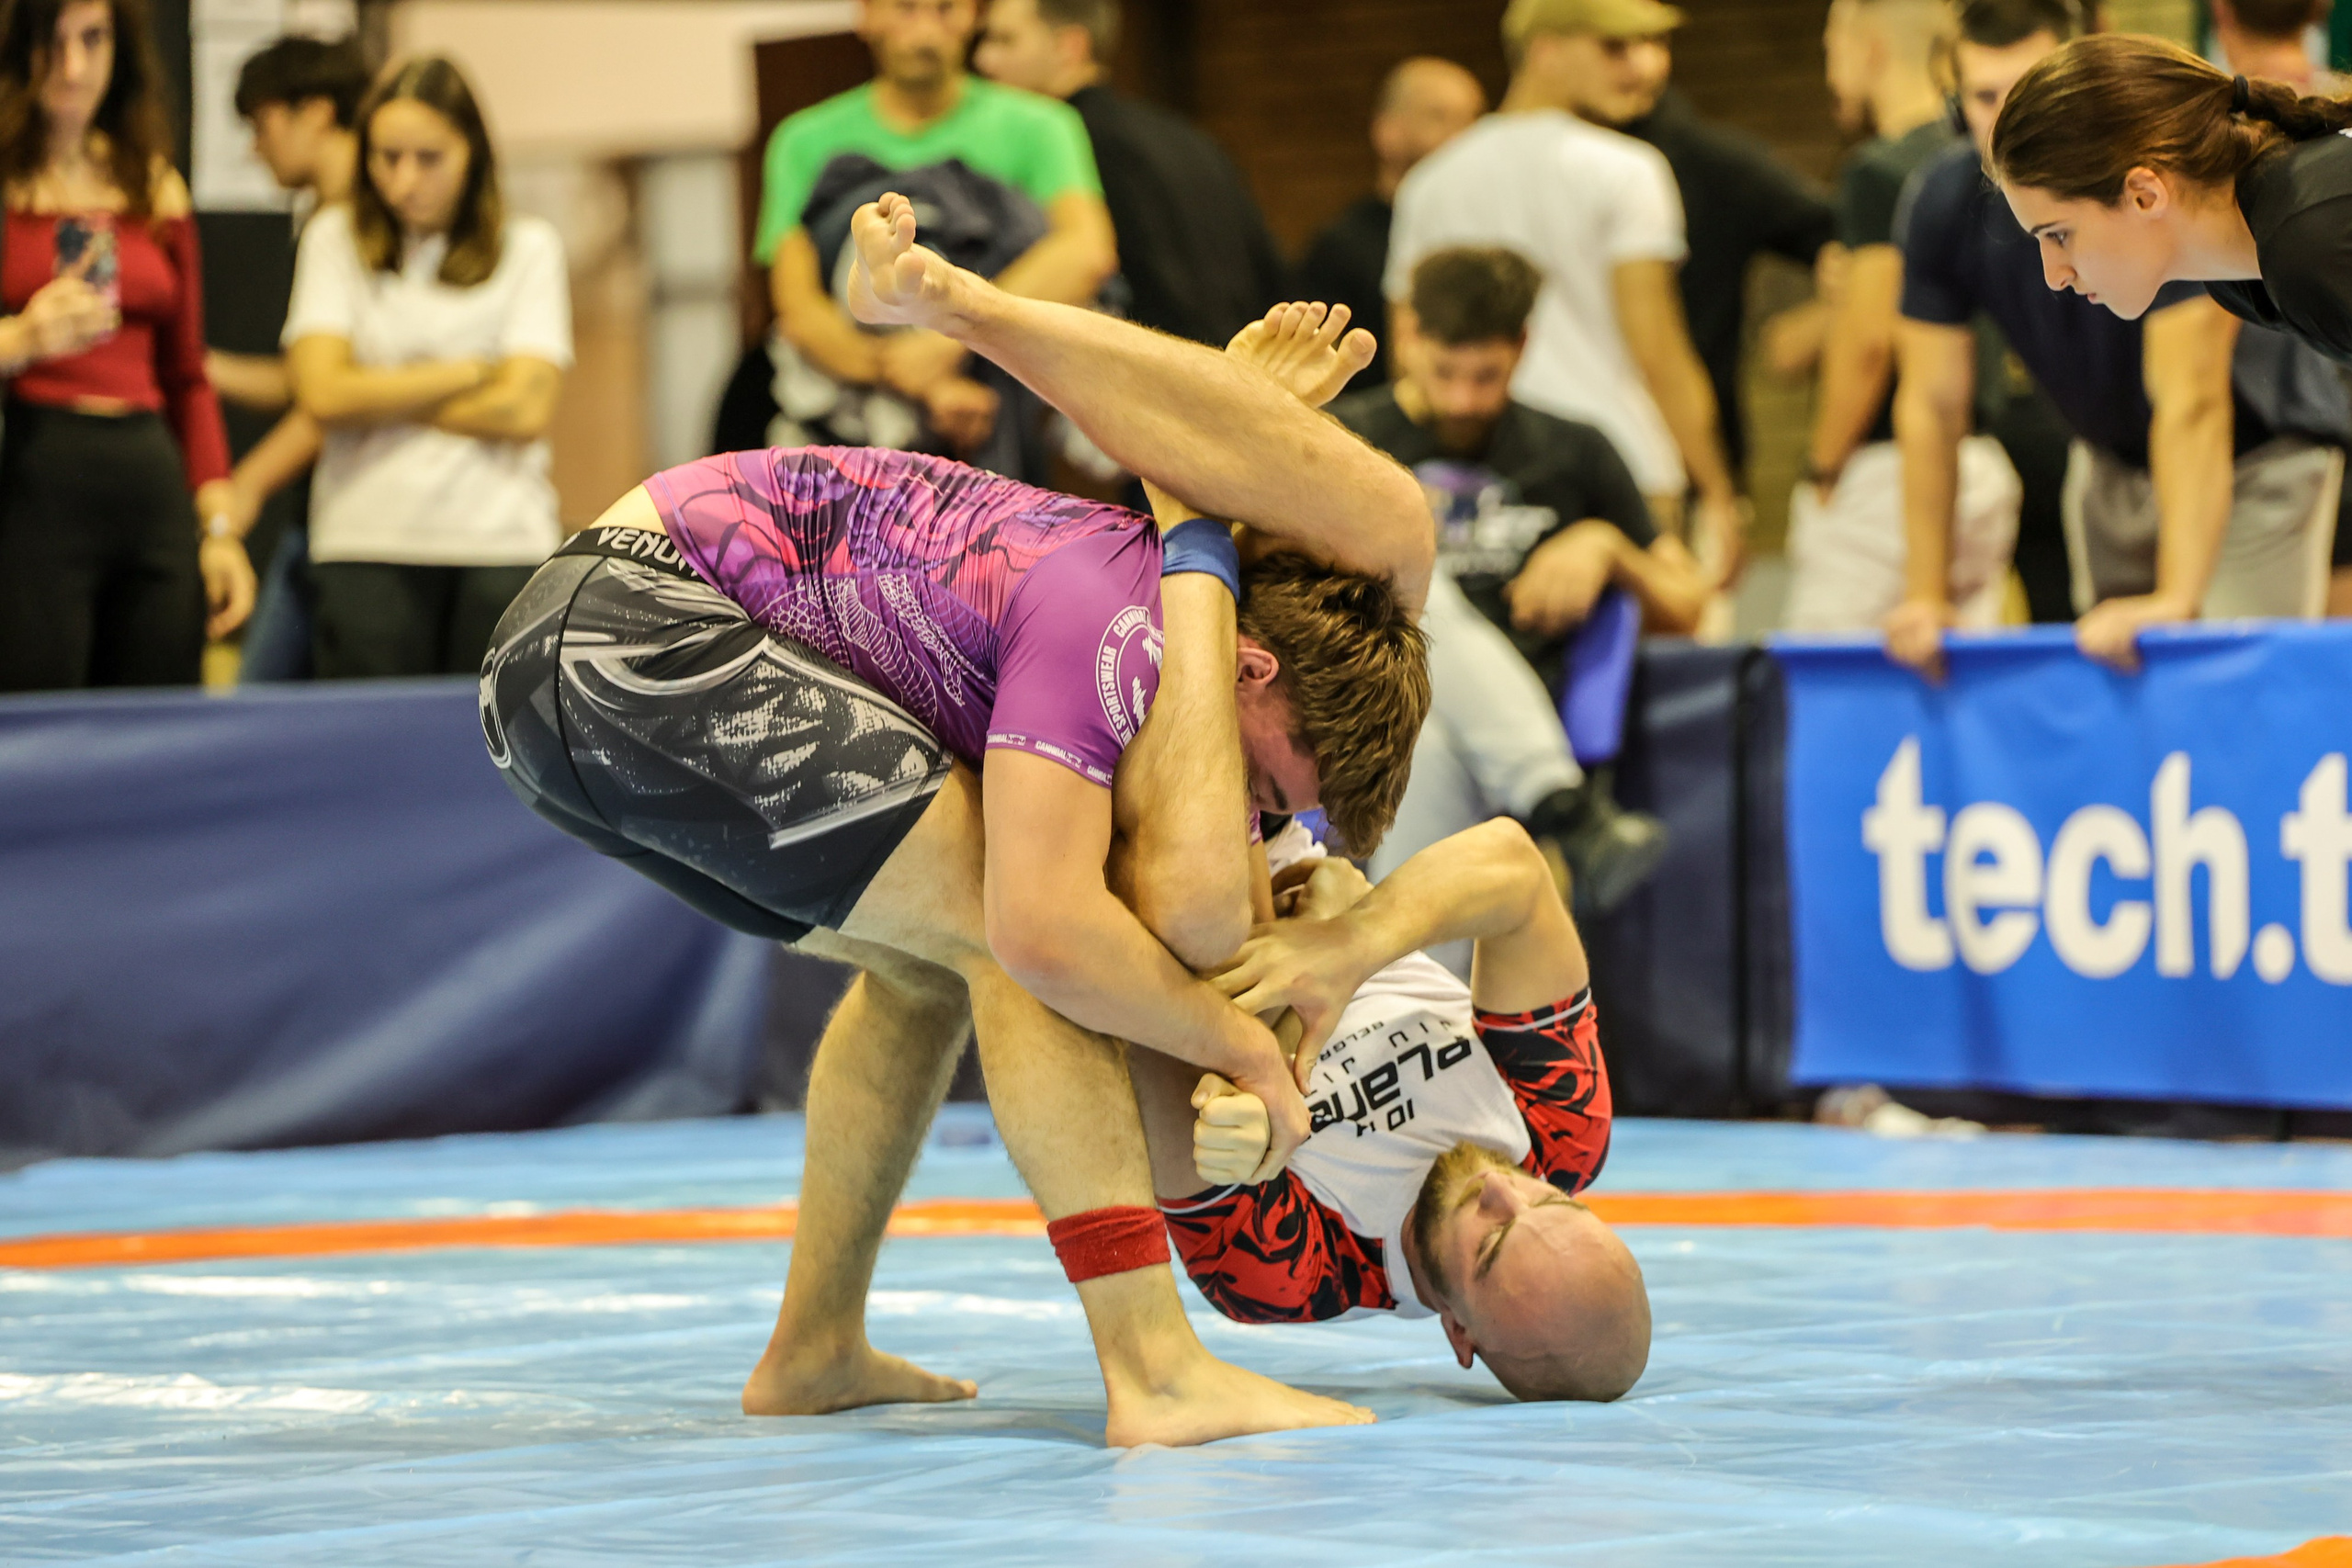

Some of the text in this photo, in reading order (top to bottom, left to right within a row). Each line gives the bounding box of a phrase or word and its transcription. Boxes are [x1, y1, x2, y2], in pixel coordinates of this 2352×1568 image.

[597, 526, 698, 577] VENU
[1100, 645, 1126, 730] SPORTSWEAR
[1861, 734, 2352, 986] tech.t
